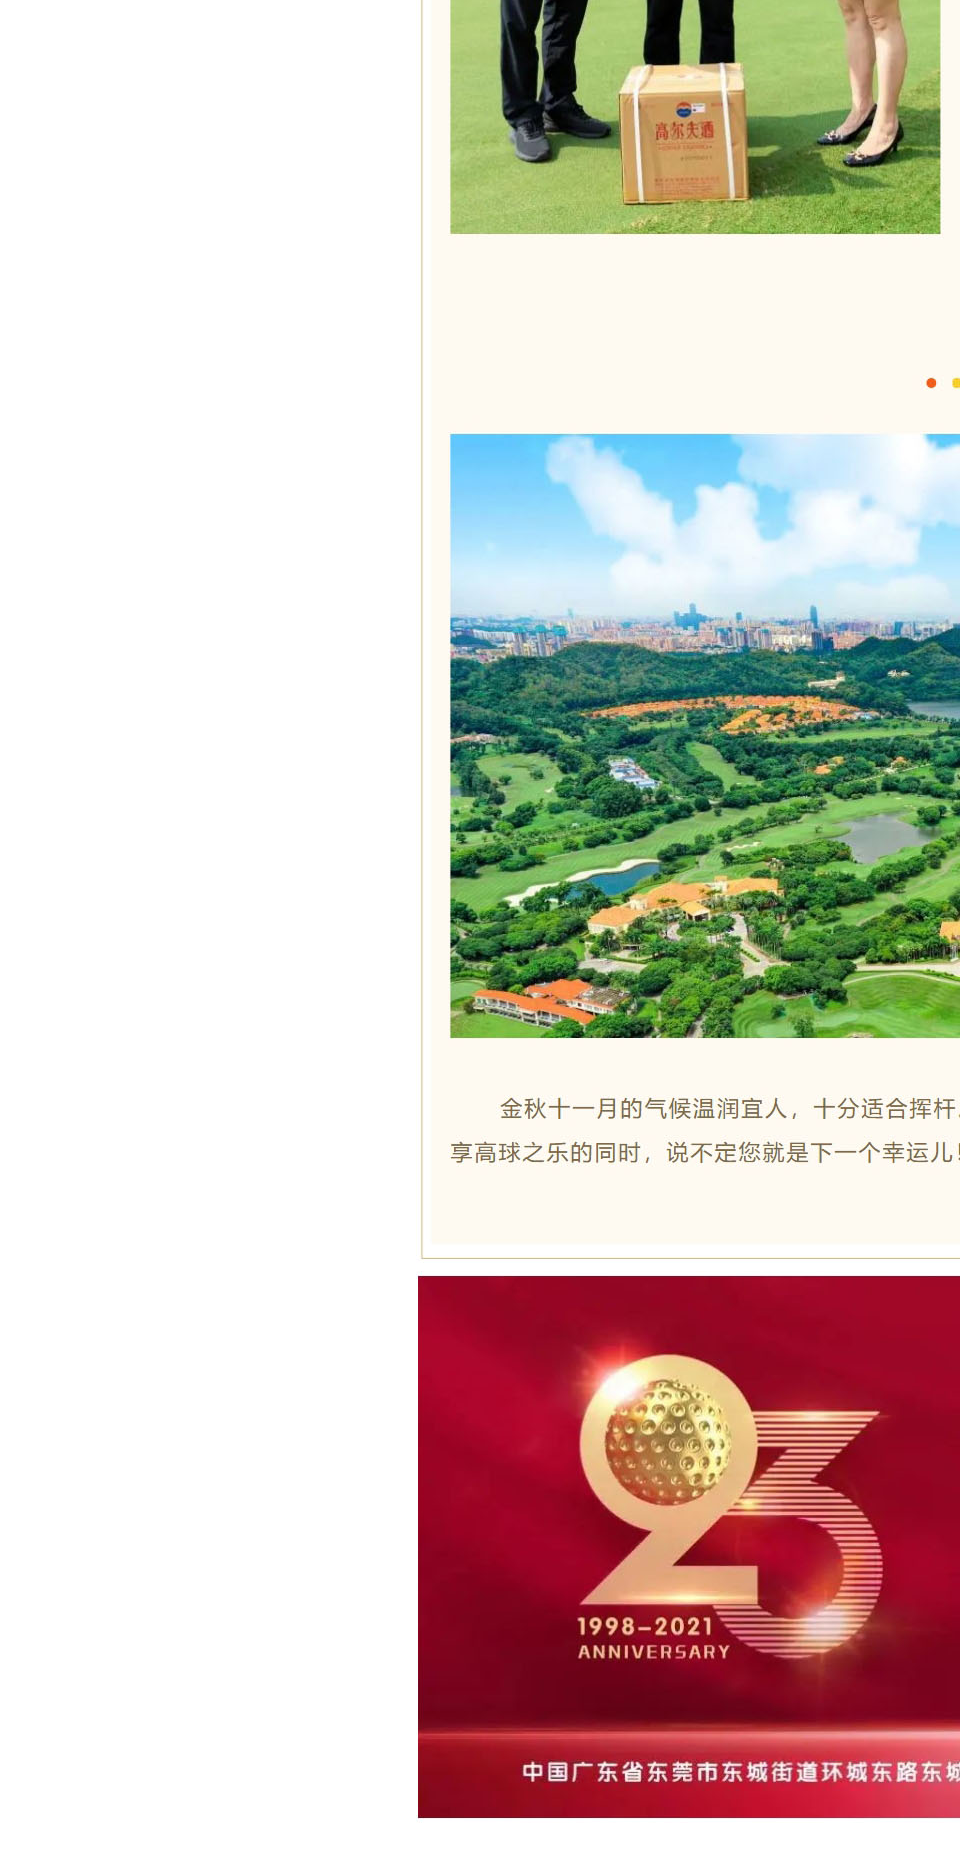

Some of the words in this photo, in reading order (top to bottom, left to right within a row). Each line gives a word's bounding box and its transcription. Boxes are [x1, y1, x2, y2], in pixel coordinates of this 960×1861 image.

[655, 120, 715, 140] 高尔夫酒
[577, 1617, 712, 1636] 1998-2021
[577, 1645, 730, 1660] ANNIVERSARY
